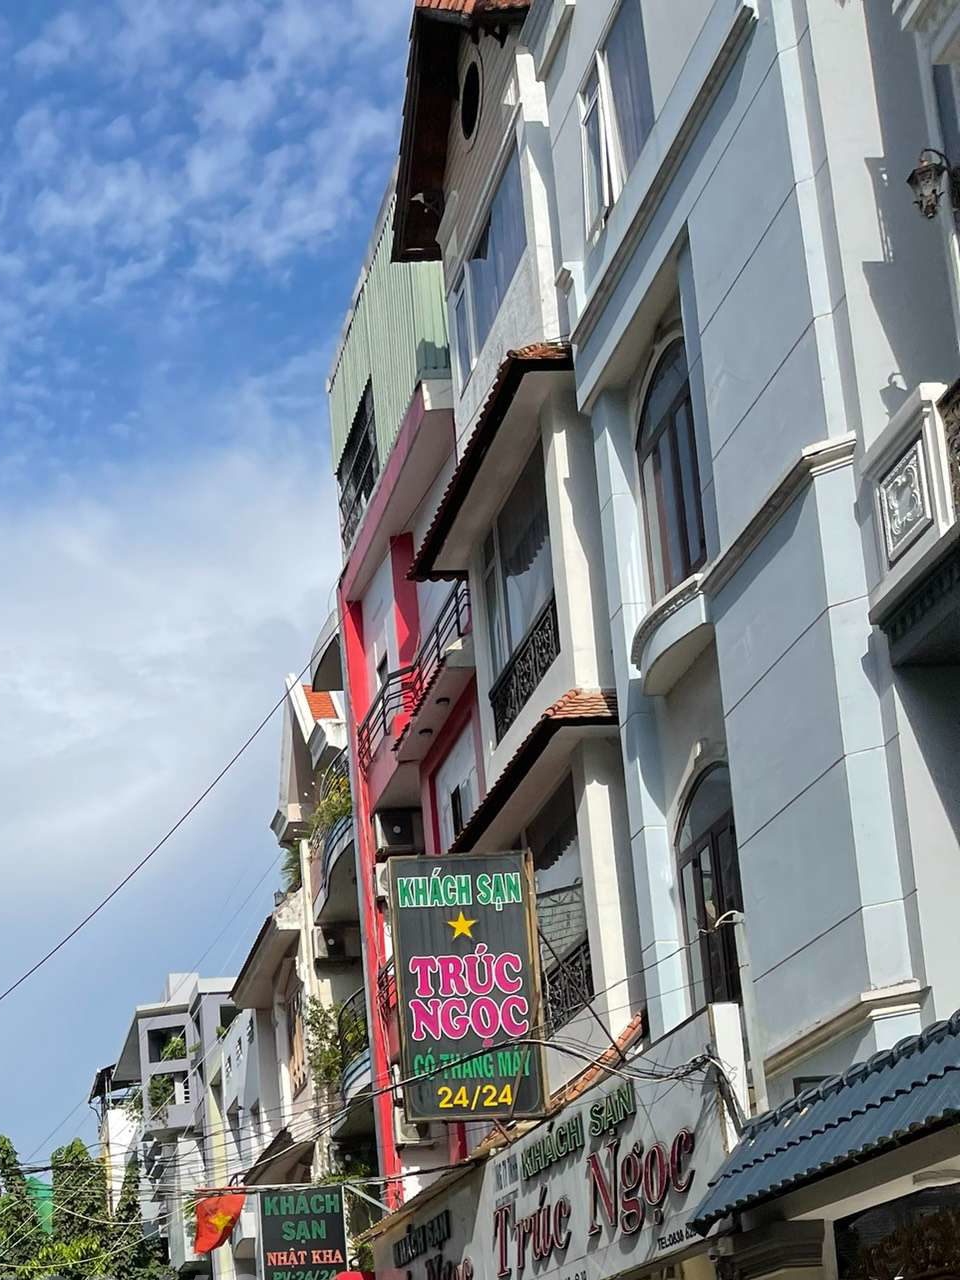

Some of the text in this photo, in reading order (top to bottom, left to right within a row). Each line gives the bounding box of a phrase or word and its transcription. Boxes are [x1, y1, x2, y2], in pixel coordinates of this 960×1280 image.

[396, 867, 523, 911] KHÁCH SẠN
[409, 943, 523, 998] TRÚC
[409, 995, 529, 1048] NGỌC
[439, 1052, 495, 1081] THANG
[496, 1046, 532, 1079] MÁY
[437, 1084, 514, 1111] 24/24
[521, 1111, 585, 1181] KHÁCH
[589, 1079, 637, 1137] SẠN
[263, 1191, 340, 1217] KHÁCH
[493, 1128, 696, 1278] Trúc Ngọc
[281, 1220, 327, 1244] SẠN
[266, 1247, 344, 1268] NHẬT KHA
